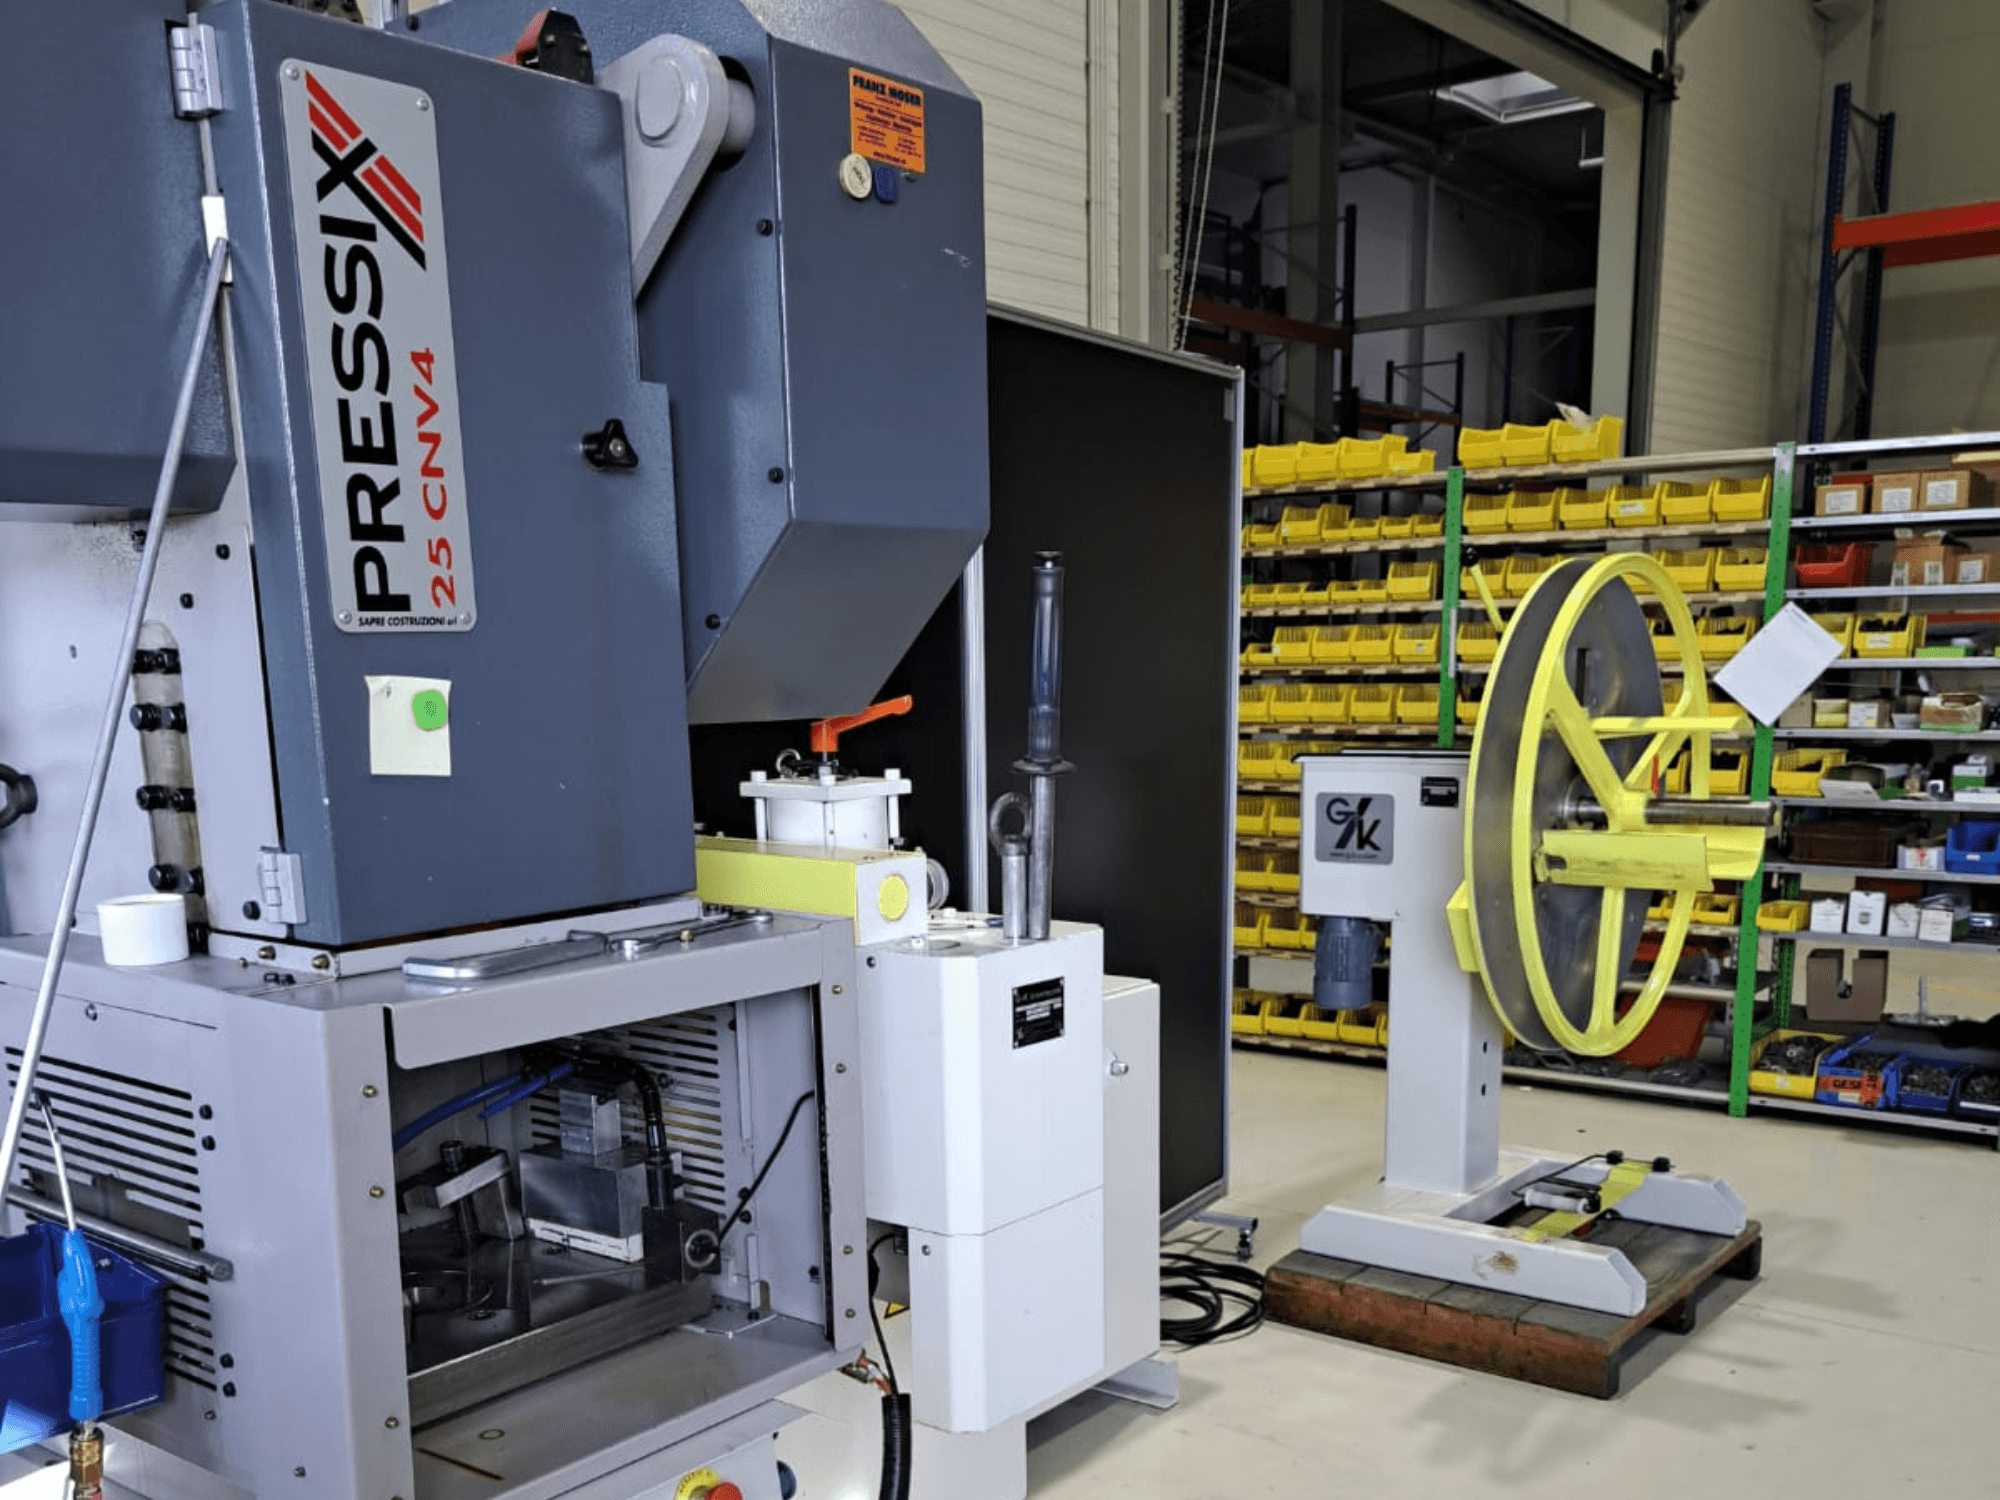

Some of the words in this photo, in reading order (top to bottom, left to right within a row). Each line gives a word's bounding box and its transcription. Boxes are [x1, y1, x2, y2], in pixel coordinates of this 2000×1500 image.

[304, 70, 427, 613] PRESSIX
[410, 347, 449, 522] CNV4
[358, 616, 385, 627] SAPRE
[387, 616, 446, 627] COSTRUZIONI
[428, 536, 456, 609] 25
